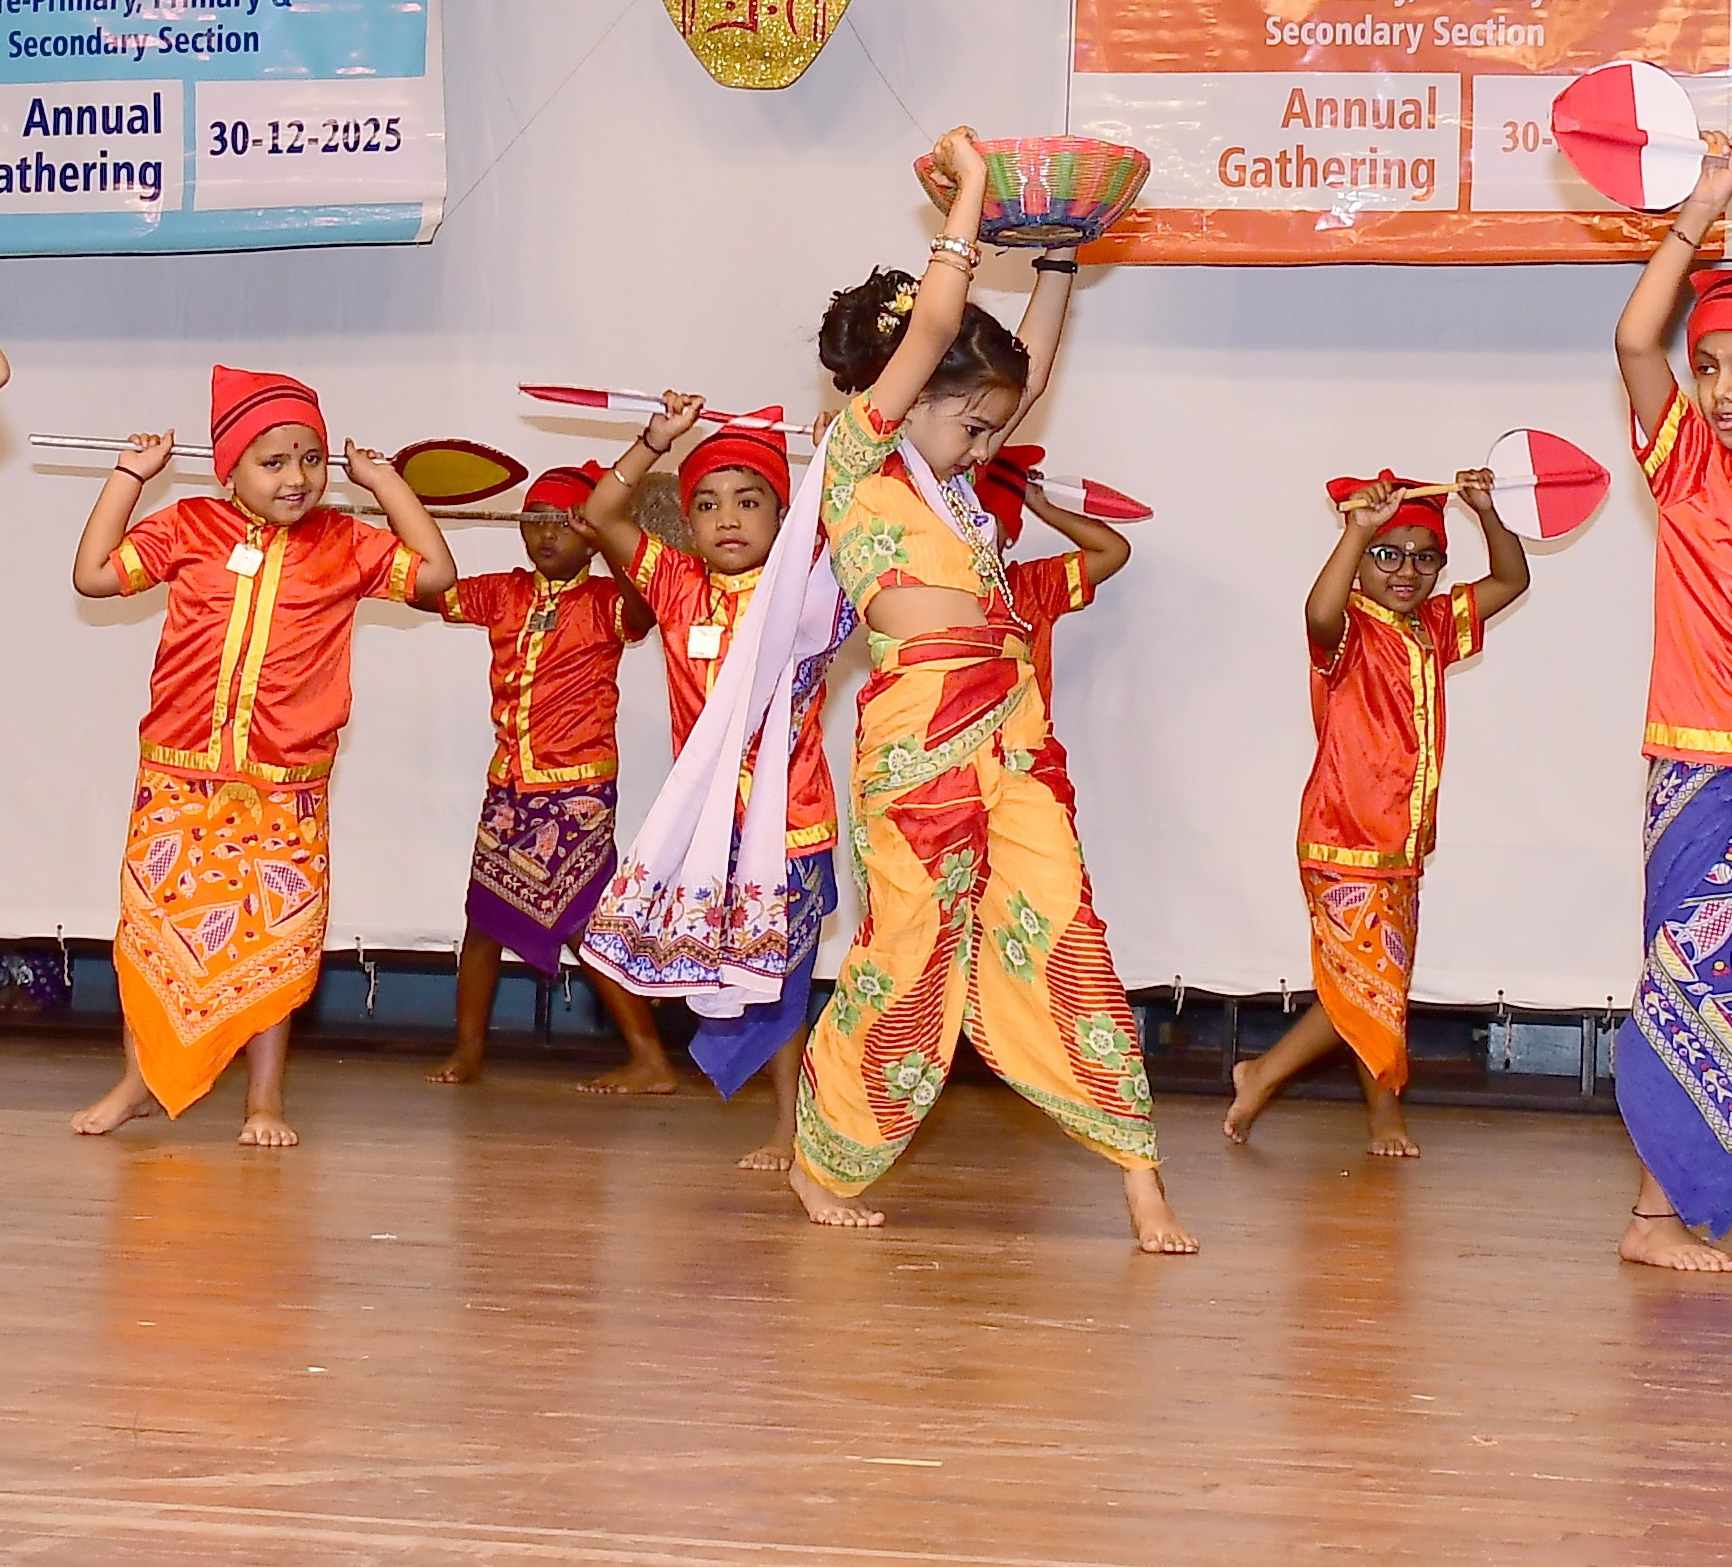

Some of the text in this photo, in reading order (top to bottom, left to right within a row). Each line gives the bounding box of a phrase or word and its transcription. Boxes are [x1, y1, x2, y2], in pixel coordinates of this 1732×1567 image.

[8, 25, 260, 62] Secondary Section
[1265, 14, 1545, 55] Secondary Section
[22, 92, 161, 137] Annual
[1280, 86, 1437, 131] Annual
[208, 117, 403, 156] 30-12-2025
[1217, 144, 1436, 202] Gathering
